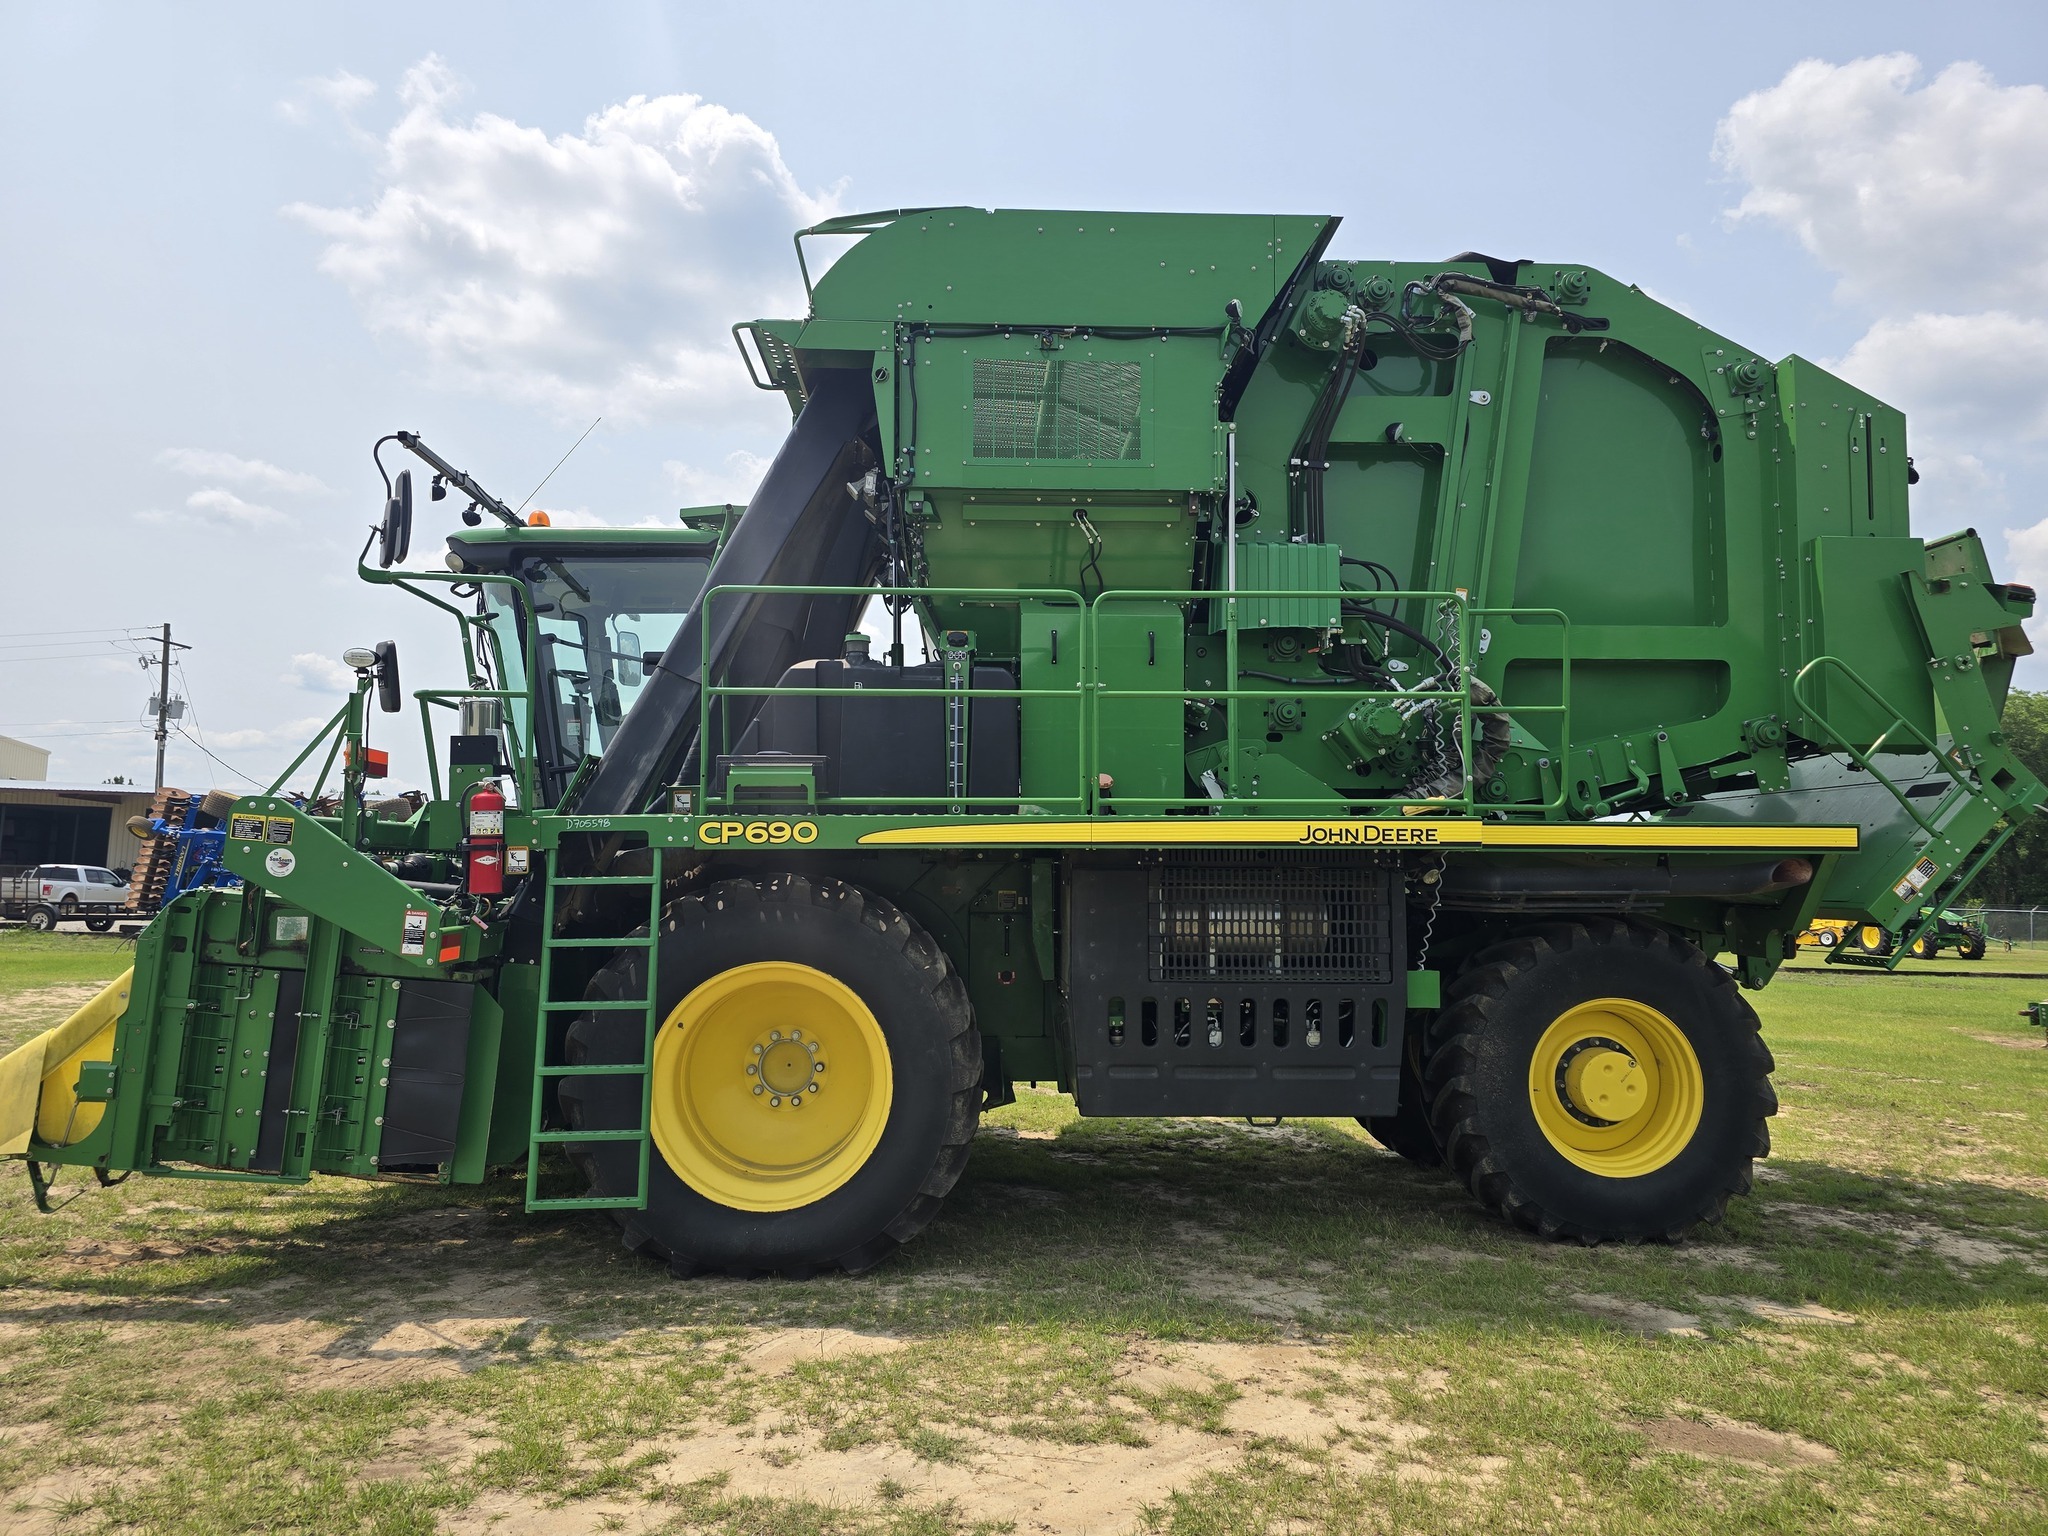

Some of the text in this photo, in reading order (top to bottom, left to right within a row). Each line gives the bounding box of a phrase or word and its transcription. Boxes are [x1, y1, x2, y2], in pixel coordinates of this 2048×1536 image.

[566, 818, 611, 830] D705598
[697, 820, 819, 845] CP690
[1300, 824, 1438, 842] JOHN DEERE
